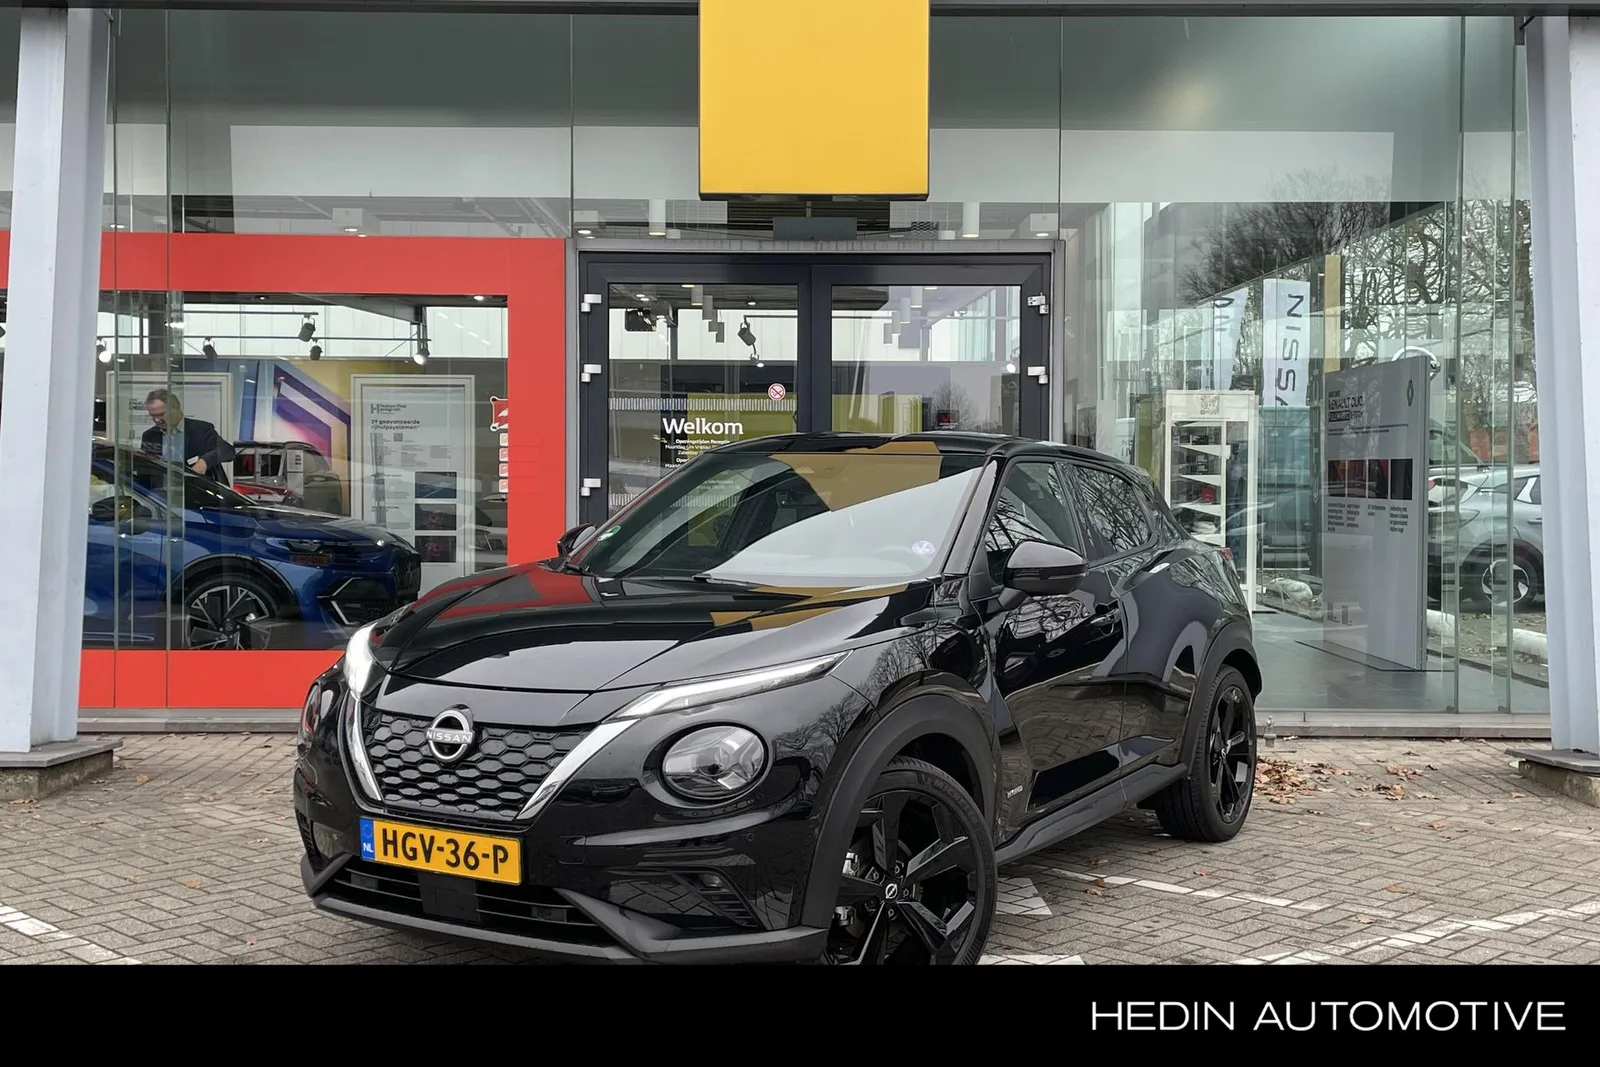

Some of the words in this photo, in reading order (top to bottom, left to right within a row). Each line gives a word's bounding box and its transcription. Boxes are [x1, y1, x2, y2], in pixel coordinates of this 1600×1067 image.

[662, 417, 744, 435] Welkom
[426, 731, 473, 743] NISSAN
[363, 842, 374, 853] NL
[382, 828, 509, 874] HGV-36-P
